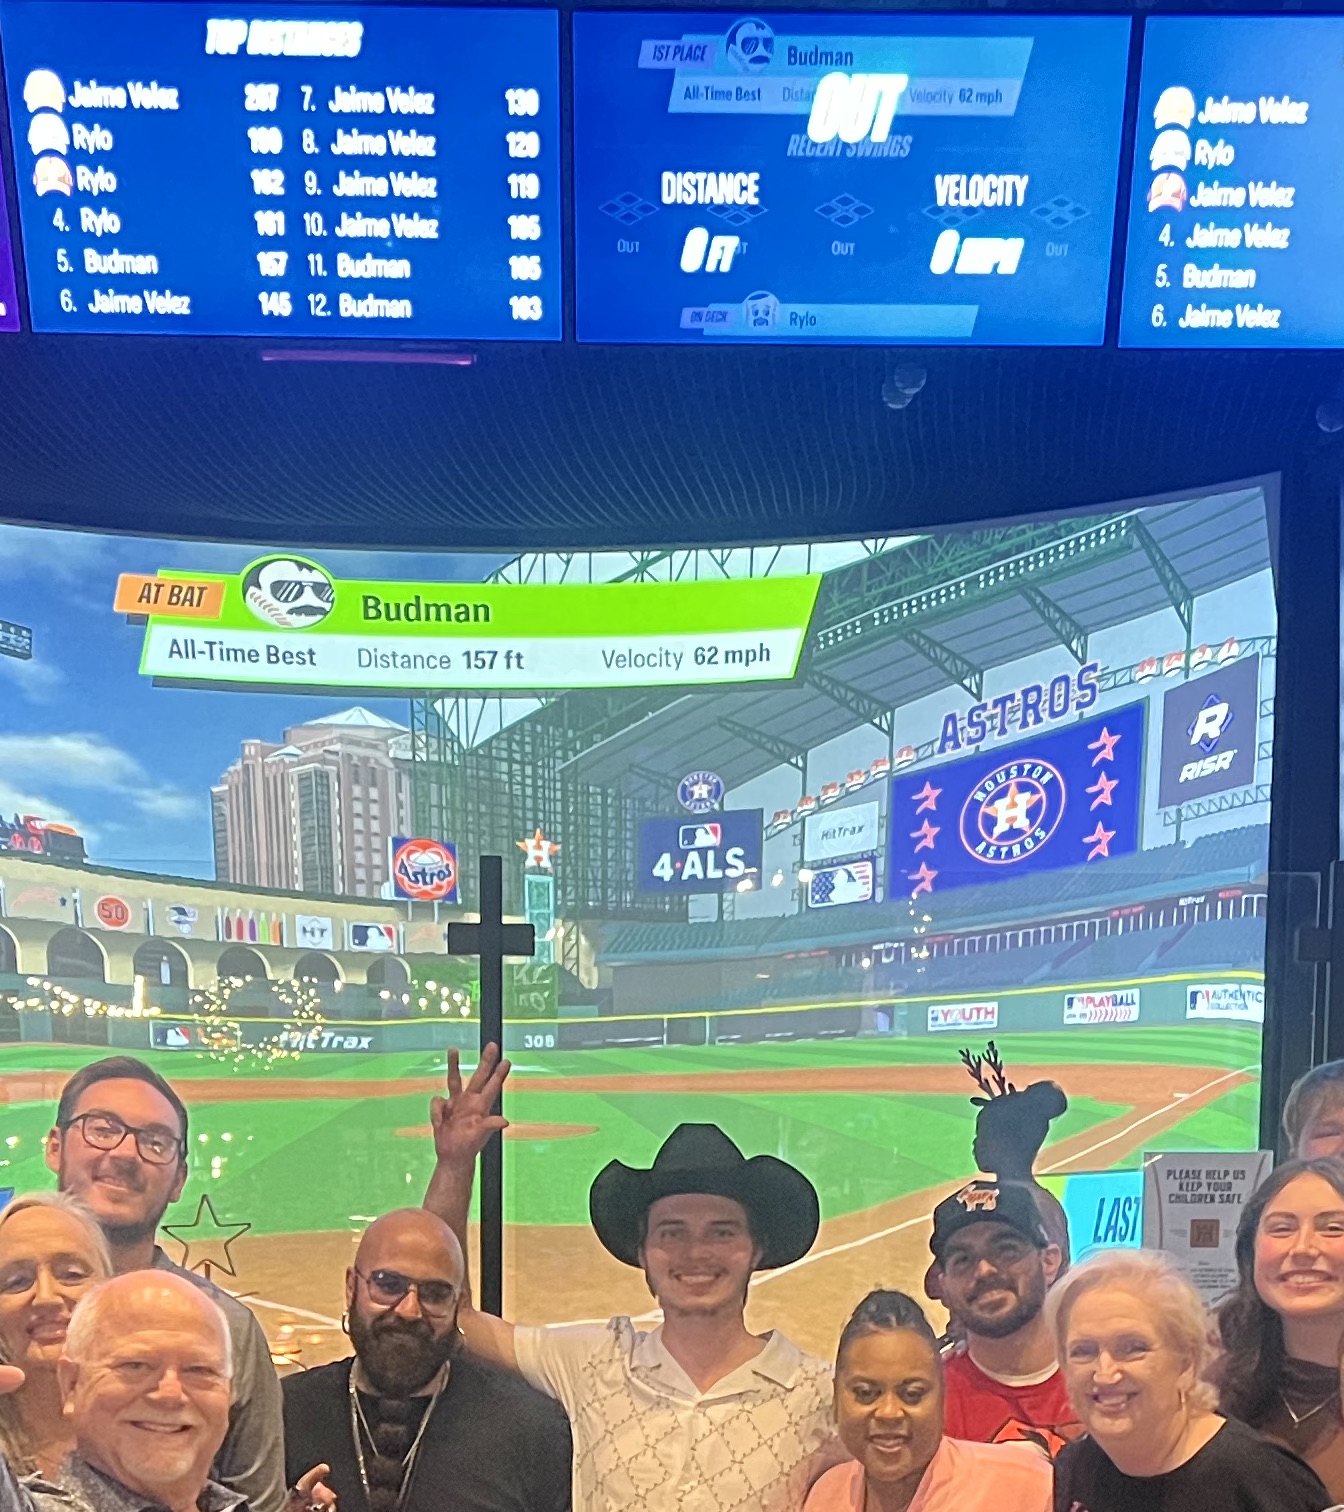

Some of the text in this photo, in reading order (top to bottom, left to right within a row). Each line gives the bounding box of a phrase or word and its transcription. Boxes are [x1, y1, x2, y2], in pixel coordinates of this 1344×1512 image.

[672, 44, 708, 62] PLACE
[787, 46, 854, 67] Budman
[683, 86, 761, 102] All-Time Best
[806, 71, 909, 144] OUT
[909, 87, 954, 105] Velocity
[975, 90, 1003, 106] mph
[71, 124, 113, 153] Rylo
[76, 165, 117, 194] Rylo
[661, 171, 760, 205] DISTANCE
[934, 174, 1029, 207] VELOCITY
[80, 208, 121, 238] Rylo
[84, 249, 158, 275] Budman
[336, 253, 411, 280] Budman
[789, 311, 818, 329] Rylo
[137, 581, 209, 609] AT BAT
[361, 594, 492, 625] Budman
[167, 638, 772, 674] All-Time Best Distance 157 ft Velocity 62 mph
[937, 662, 1099, 754] ASTROS
[1190, 702, 1229, 746] R
[1179, 750, 1237, 783] RISR
[973, 763, 1054, 802] HOUSTON
[975, 827, 1046, 860] ASTROS
[398, 857, 453, 887] Astros
[101, 904, 125, 922] 50
[940, 1006, 995, 1023] YOUTH
[1167, 1169, 1245, 1180] PLEASE HELP US
[1179, 1181, 1232, 1192] KEEP YOUR
[1168, 1193, 1242, 1204] CHILDREN SAFE
